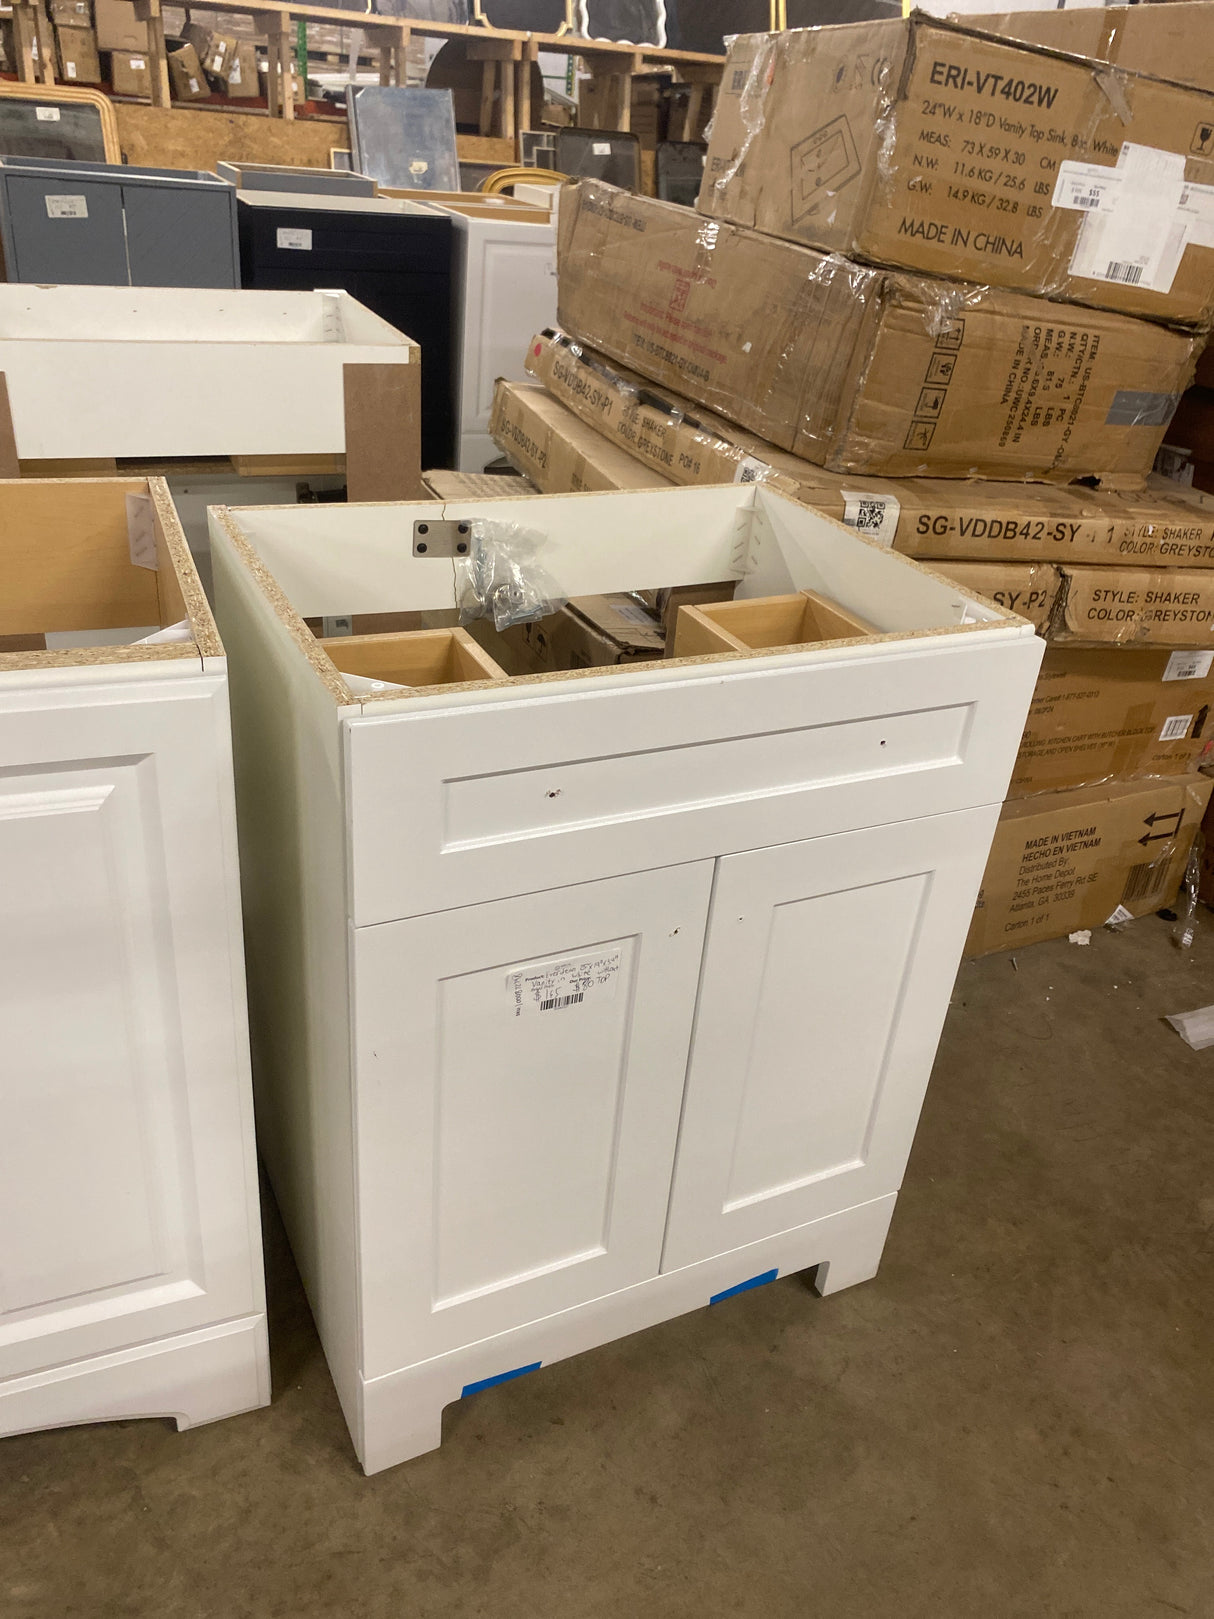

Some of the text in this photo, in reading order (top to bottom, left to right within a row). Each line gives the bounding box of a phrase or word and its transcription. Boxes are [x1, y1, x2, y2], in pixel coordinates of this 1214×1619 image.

[929, 61, 1058, 110] ERI-VT402W
[999, 117, 1027, 139] Vanity
[1029, 124, 1045, 143] Top
[1093, 139, 1119, 158] White
[919, 129, 952, 148] MEAS:
[961, 140, 976, 155] 73
[987, 146, 1001, 160] 59
[1012, 152, 1026, 166] 30
[1039, 156, 1057, 172] CM
[953, 161, 976, 179] 11.6
[977, 168, 994, 183] KG
[1003, 174, 1027, 191] 25.6
[1033, 181, 1051, 196] LBS
[947, 185, 970, 201] 14.9
[970, 193, 987, 206] KG
[996, 198, 1019, 214] 32.8
[1026, 205, 1044, 219] LBS
[897, 216, 1024, 259] MADE IN CHINA
[1012, 358, 1021, 370] IN
[1000, 372, 1017, 405] CHINA
[1054, 377, 1065, 389] 75
[1030, 407, 1043, 426] LBS
[1042, 407, 1055, 427] LBS
[1055, 408, 1067, 422] PC
[641, 416, 667, 440] SHAKER
[1012, 432, 1022, 443] IN
[637, 434, 674, 466] GREYSTONE
[1162, 527, 1202, 540] SHAKER
[1119, 540, 1158, 554] COLOR:
[1092, 589, 1200, 605] STYLE: SHAKER
[1087, 607, 1140, 621] COLOR:
[1024, 827, 1097, 850] MADE IN VIETNAM
[1022, 838, 1101, 862] HECHO EN VIETNAM
[1019, 859, 1057, 875] Distributed
[1016, 867, 1076, 888] The Home Depot
[1032, 884, 1054, 896] Paces
[1055, 879, 1074, 891] Ferry
[1075, 876, 1086, 886] Rd
[1086, 873, 1098, 883] SE
[1037, 897, 1050, 906] GA
[1004, 920, 1028, 932] Carton
[1036, 914, 1044, 924] of
